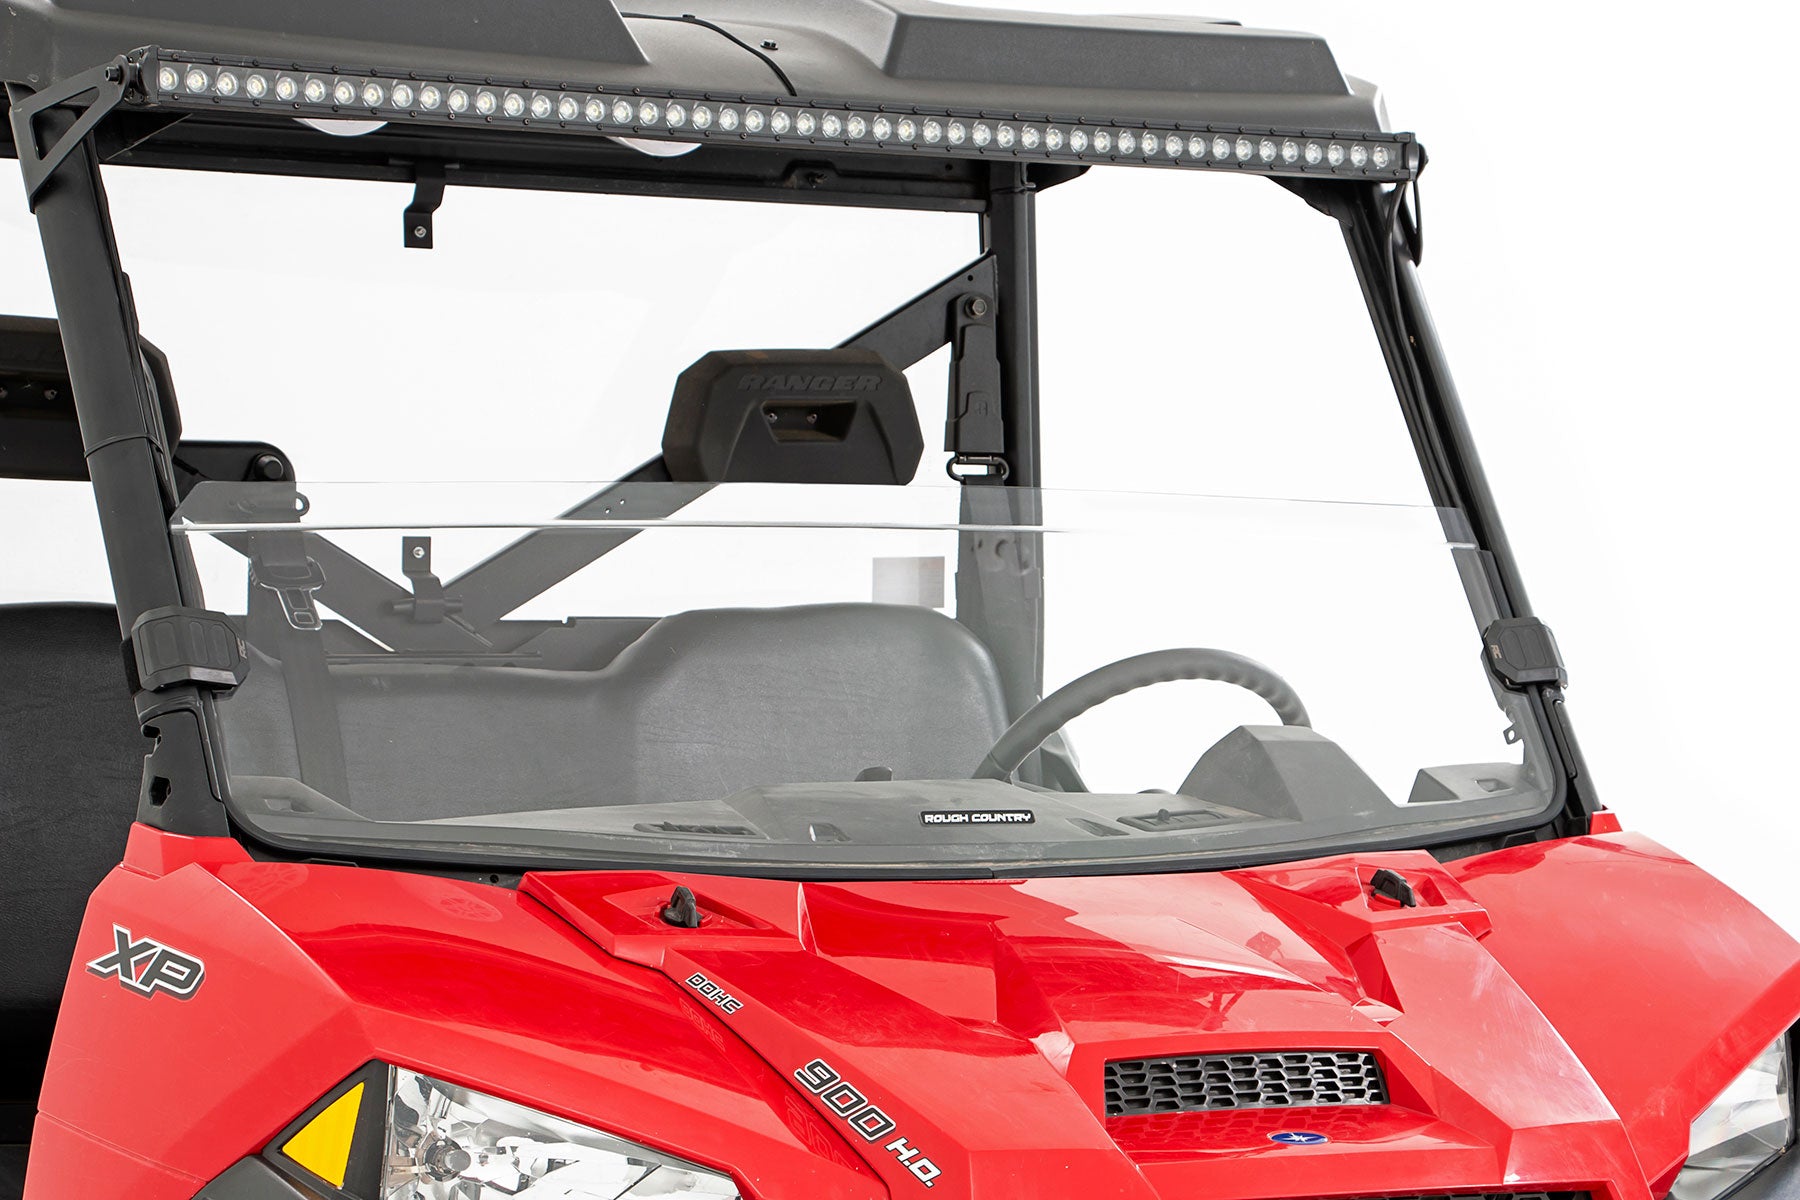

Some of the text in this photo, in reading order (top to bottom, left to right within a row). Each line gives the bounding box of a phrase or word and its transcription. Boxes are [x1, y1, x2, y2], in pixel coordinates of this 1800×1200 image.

[738, 374, 883, 391] RANGER
[924, 812, 1032, 824] ROUGH COUNTRY
[85, 922, 206, 1001] XP
[685, 971, 744, 1015] DOHC
[794, 1058, 896, 1142] 900
[884, 1136, 943, 1188] H.O.
